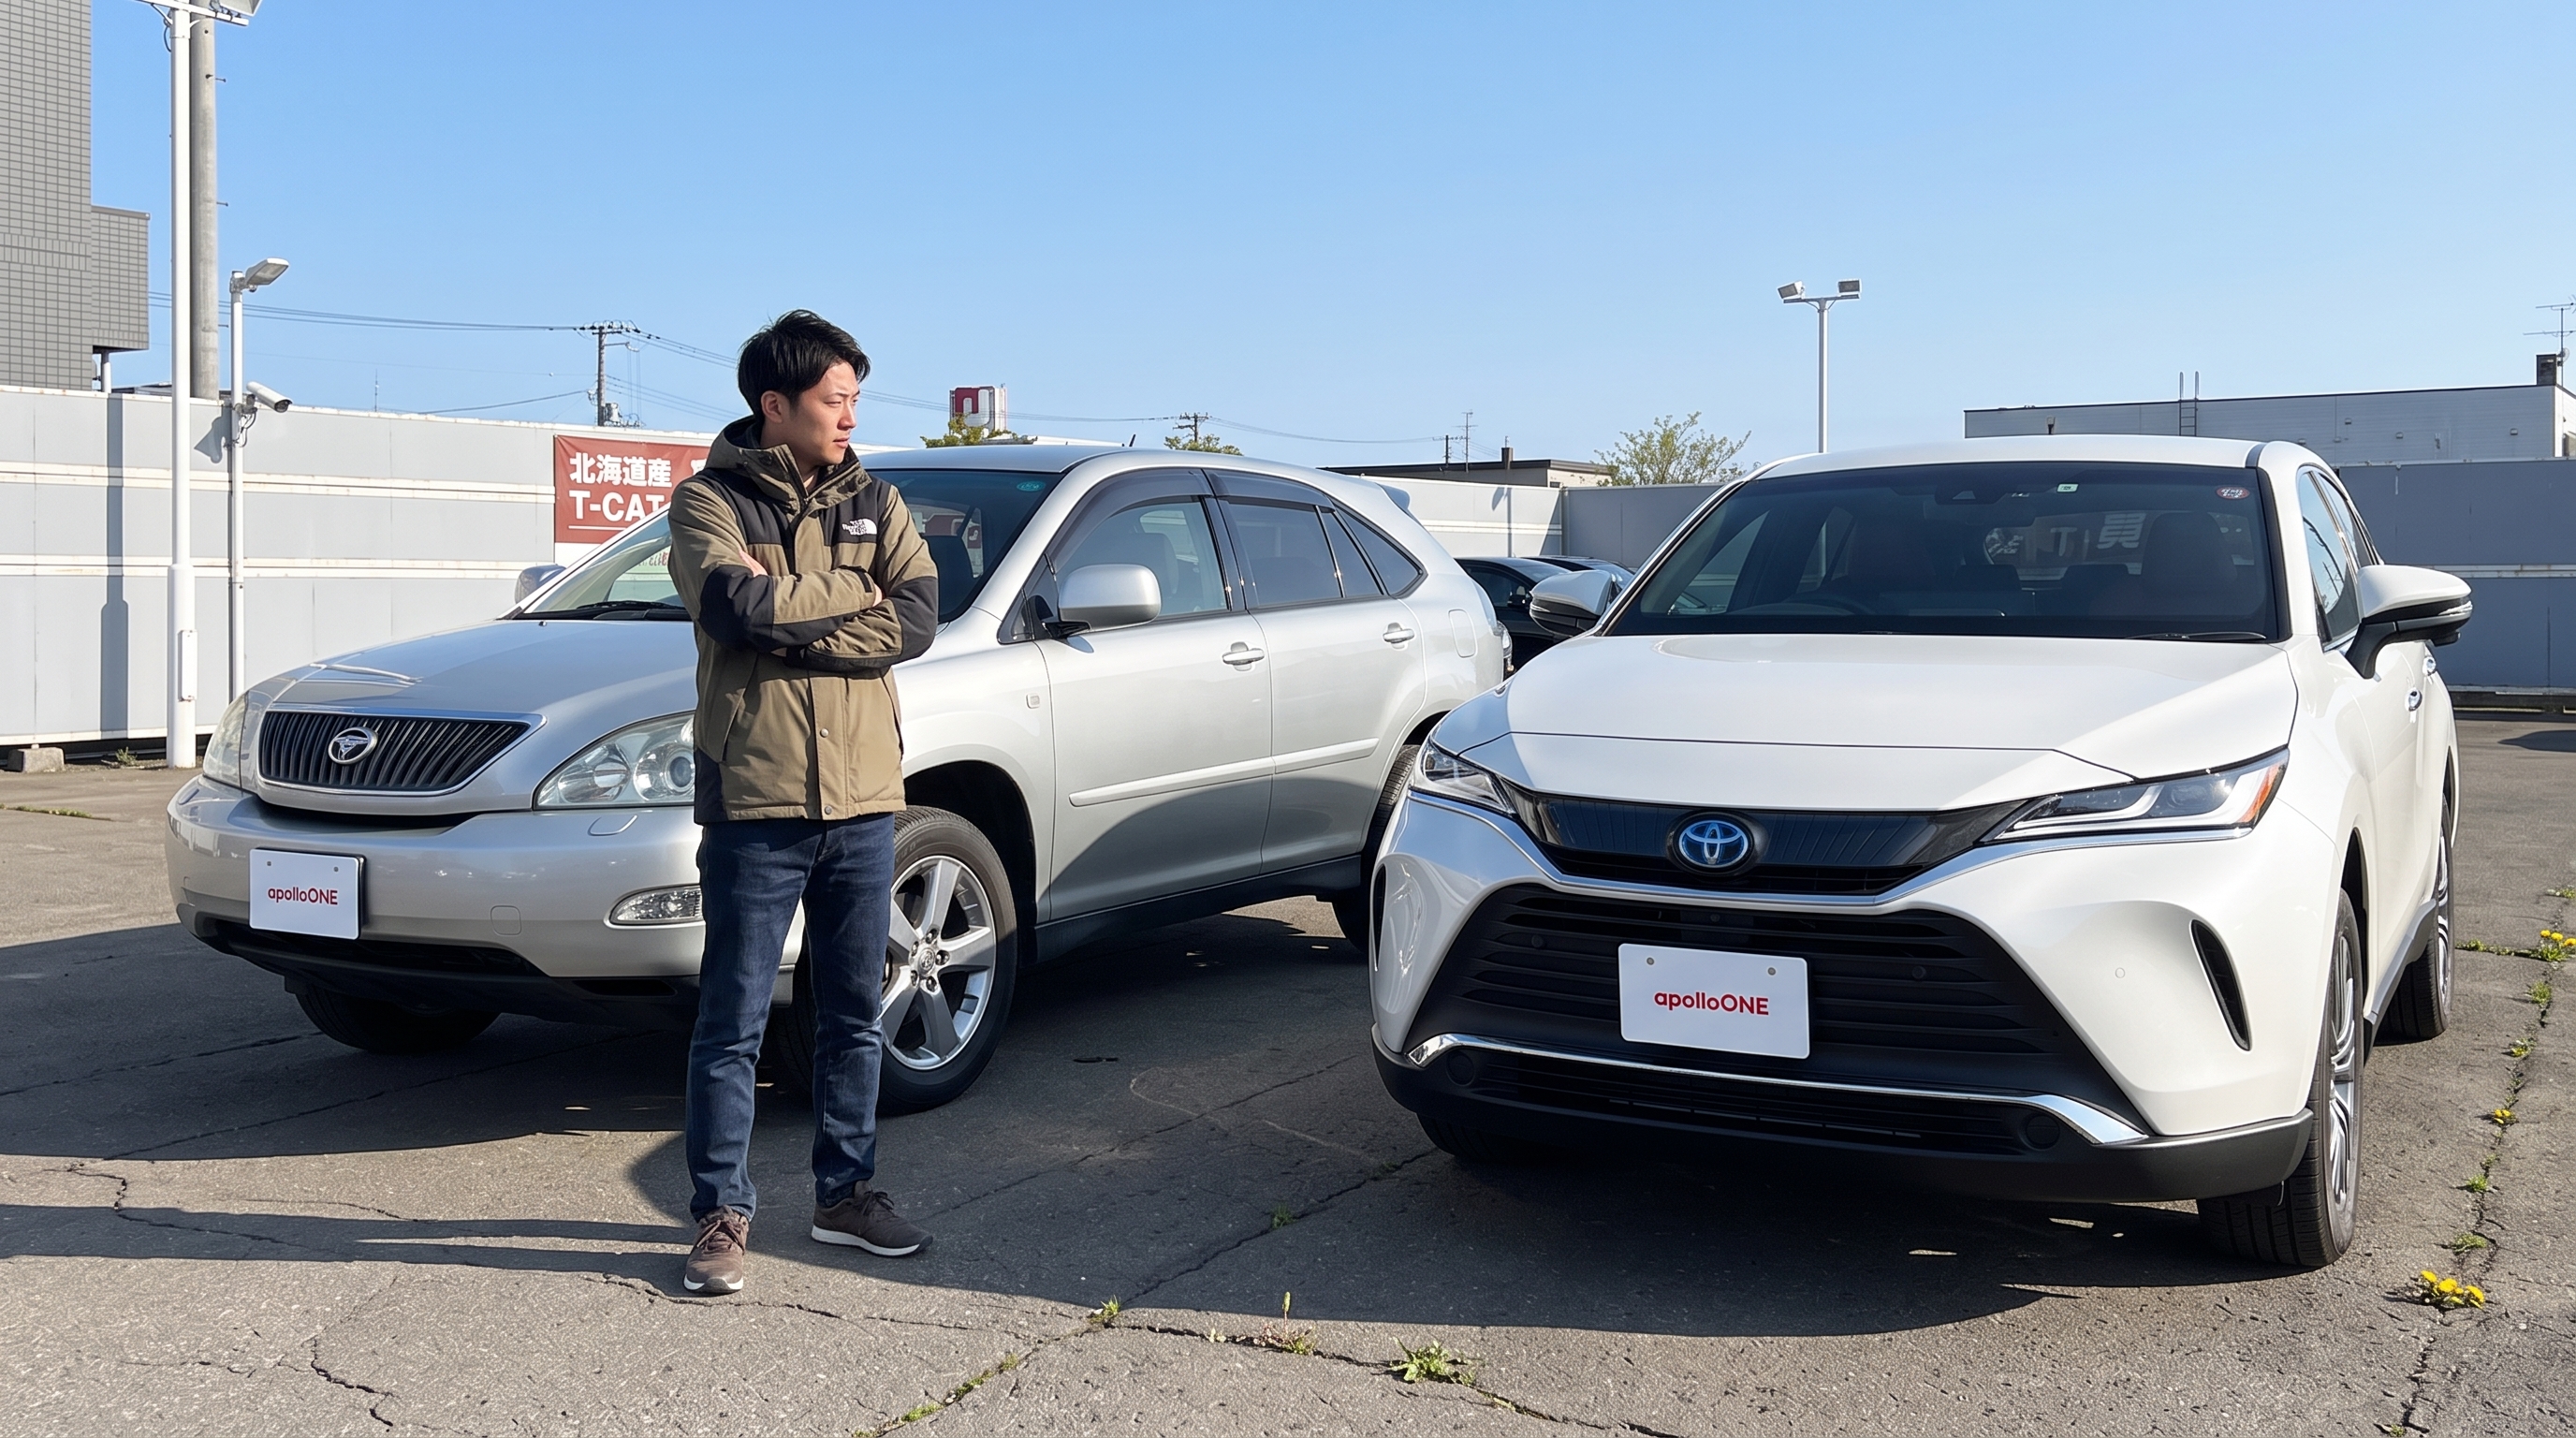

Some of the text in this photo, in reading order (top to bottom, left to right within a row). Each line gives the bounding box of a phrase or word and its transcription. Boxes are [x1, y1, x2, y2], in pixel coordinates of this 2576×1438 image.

[569, 452, 672, 488] 北海道産
[268, 887, 339, 905] apolloONE
[1654, 991, 1769, 1016] apolloONE
